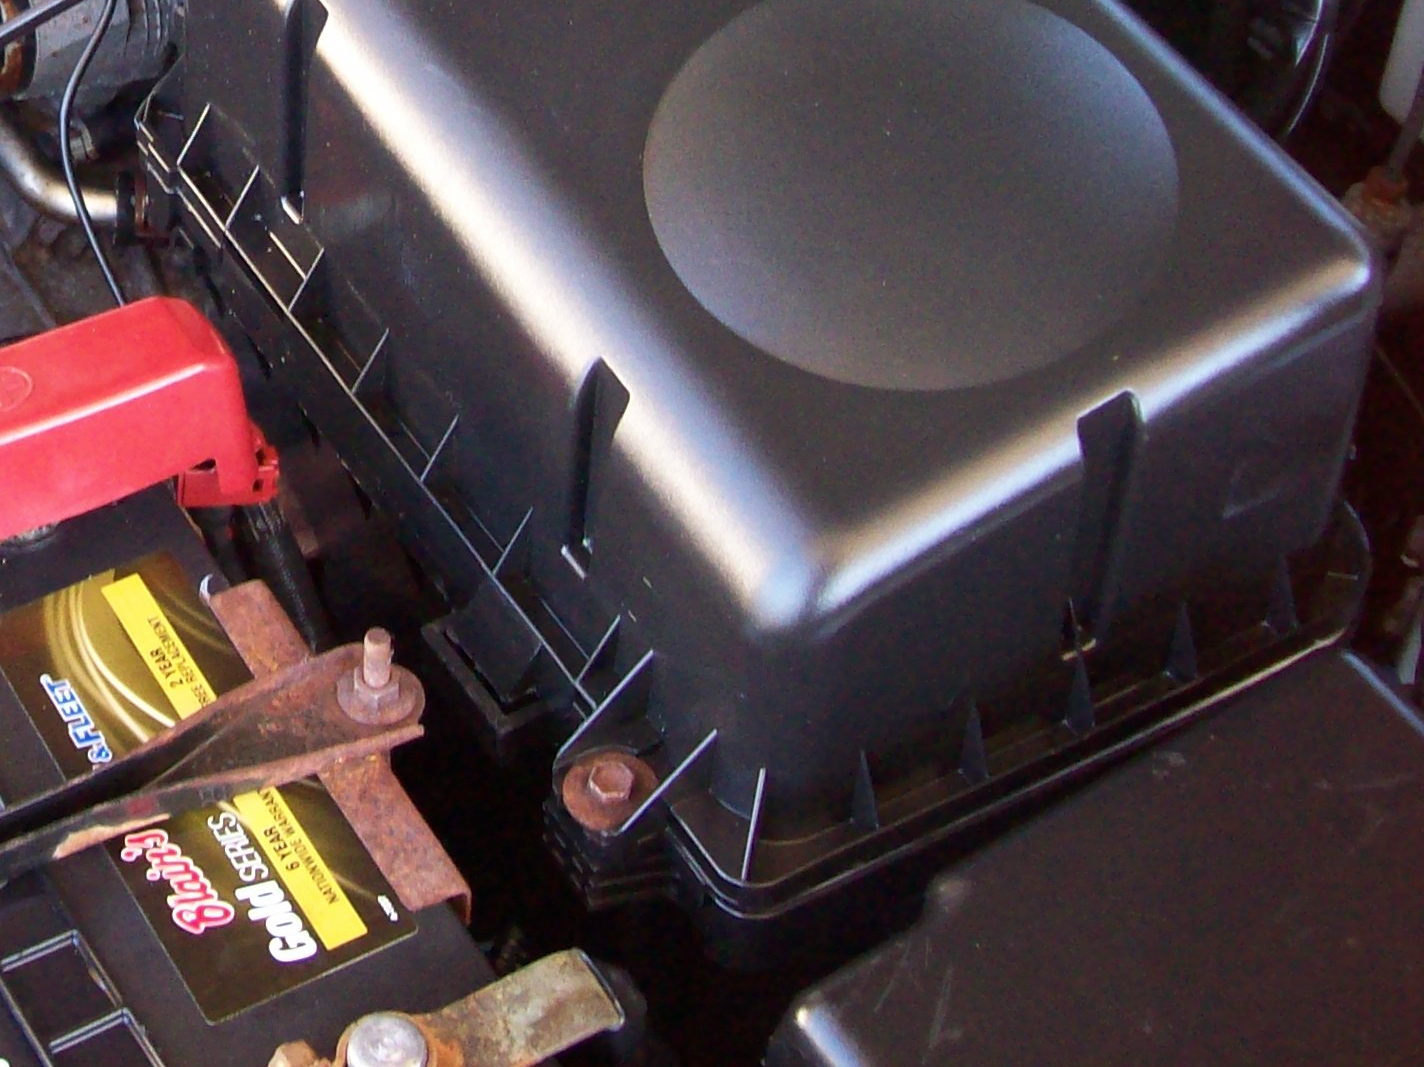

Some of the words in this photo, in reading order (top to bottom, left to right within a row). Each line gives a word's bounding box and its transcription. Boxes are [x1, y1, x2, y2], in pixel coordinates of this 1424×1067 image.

[147, 616, 198, 684] REPLACEMENT
[149, 647, 177, 680] YEAR
[169, 677, 184, 689] 2
[40, 674, 106, 749] FLEET
[208, 812, 269, 882] SERIES
[263, 826, 293, 861] YEAR
[285, 861, 300, 871] 6
[290, 838, 340, 905] NATIONWIDE
[121, 829, 235, 934] Blair's
[235, 880, 318, 963] Gold
